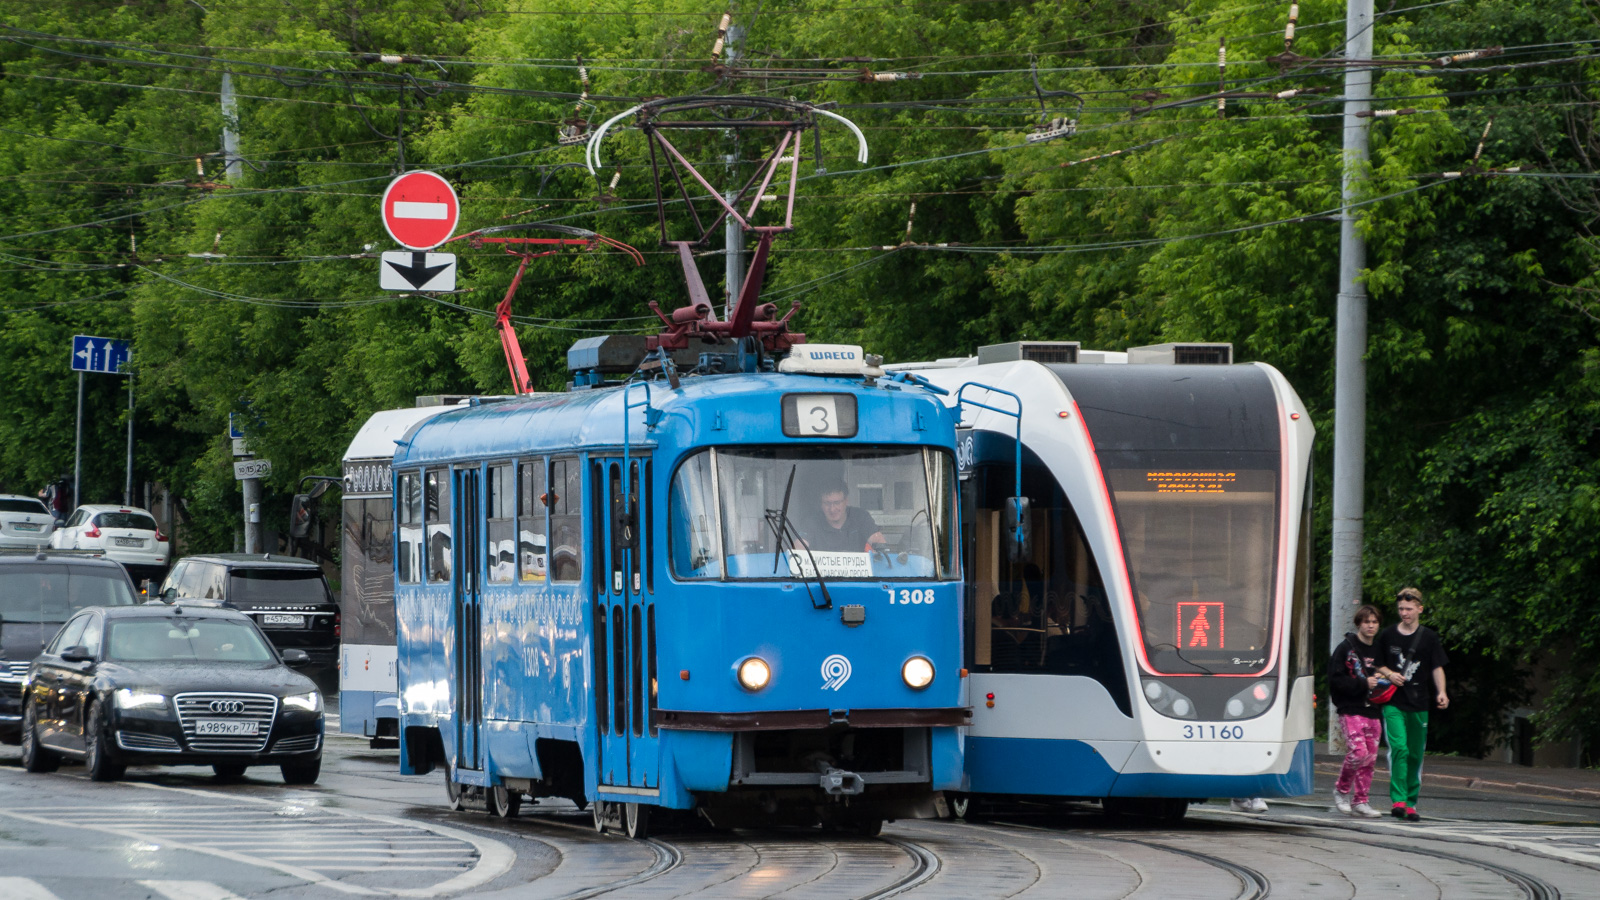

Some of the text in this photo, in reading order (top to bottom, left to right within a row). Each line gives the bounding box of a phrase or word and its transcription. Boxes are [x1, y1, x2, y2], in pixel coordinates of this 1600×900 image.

[810, 352, 855, 360] WAECO
[809, 406, 829, 433] 3
[246, 465, 255, 473] 15
[256, 463, 268, 473] 20
[843, 556, 867, 568] ПРУДЫ
[888, 589, 935, 605] 1308
[523, 647, 540, 677] 1308
[200, 722, 256, 733] А989КР 777
[1183, 724, 1244, 739] 31160
